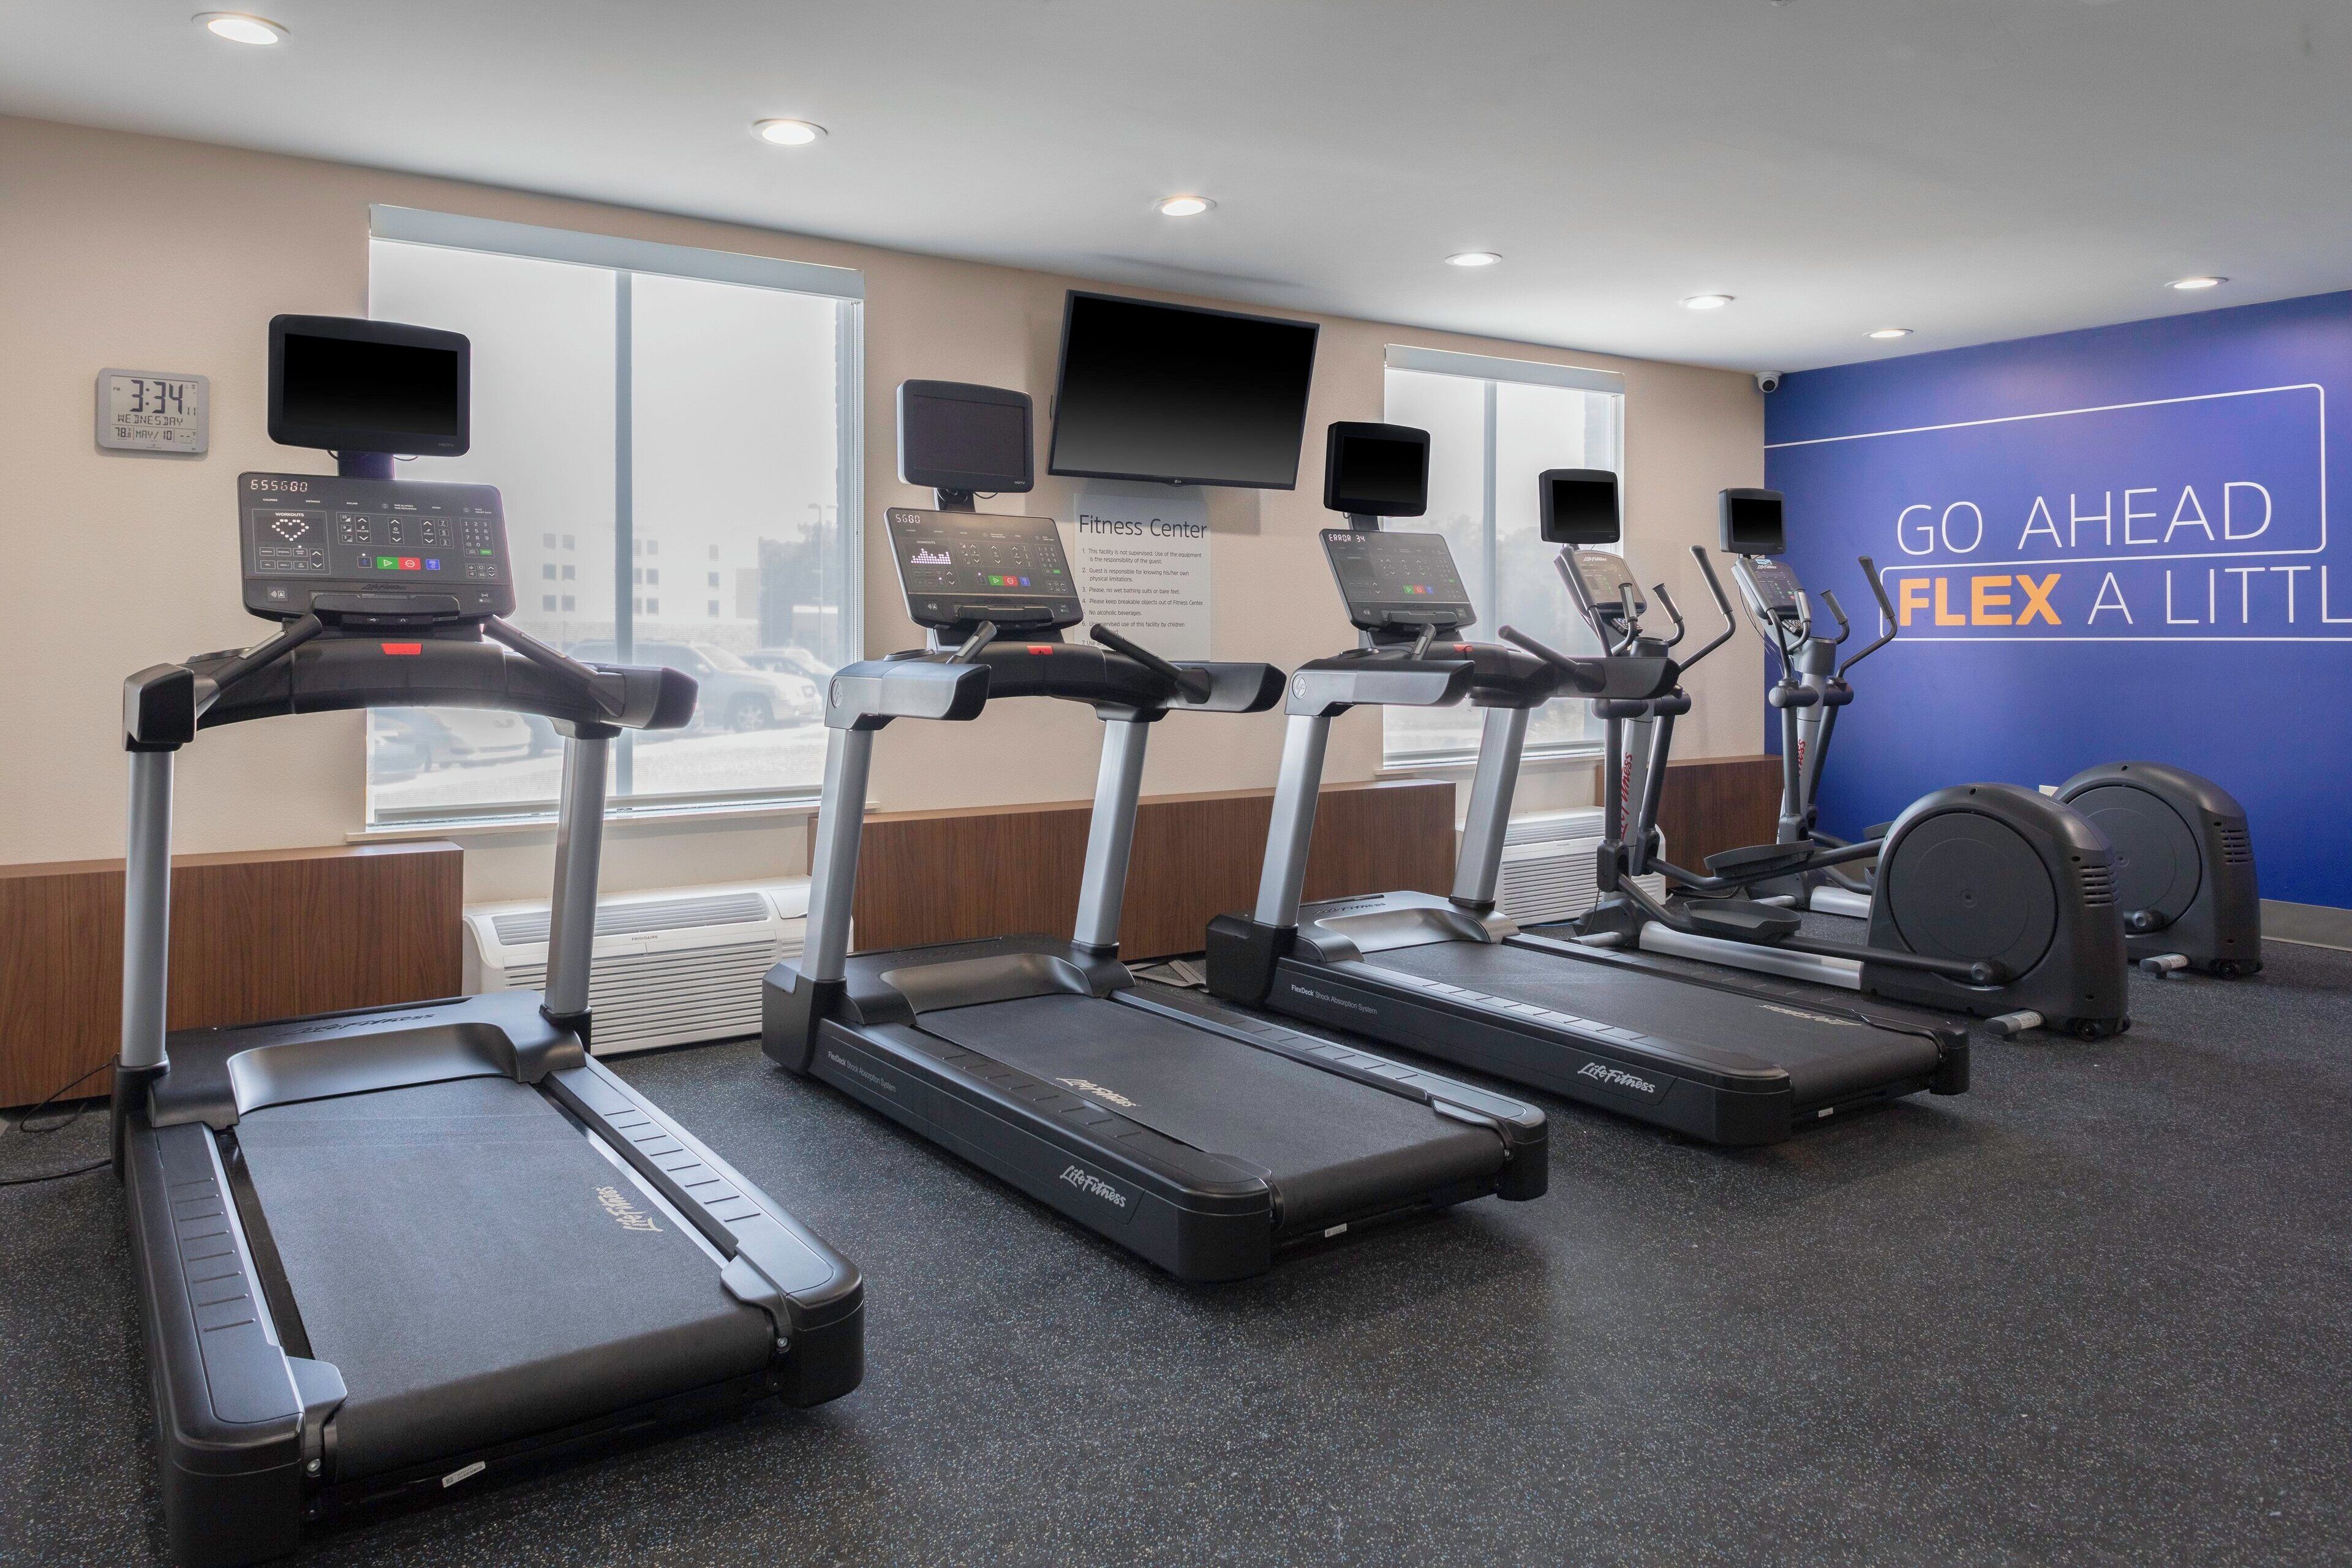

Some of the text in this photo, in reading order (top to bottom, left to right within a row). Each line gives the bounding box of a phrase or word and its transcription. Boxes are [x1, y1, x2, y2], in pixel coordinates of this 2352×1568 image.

[130, 380, 183, 415] 3:34
[118, 414, 183, 426] WEDNESDAY
[164, 431, 172, 440] 10
[1080, 514, 1207, 538] Fitness Center
[1897, 481, 2272, 556] GO AHEAD
[1899, 565, 2352, 627] FLEX A LITTL
[1291, 984, 1378, 1015] FlexDeck Shock Absorption System
[828, 1050, 896, 1093] FlexDeck Shock Absorption System
[1577, 1062, 1656, 1093] Life Fitness
[1060, 1165, 1126, 1207] Life Fitness
